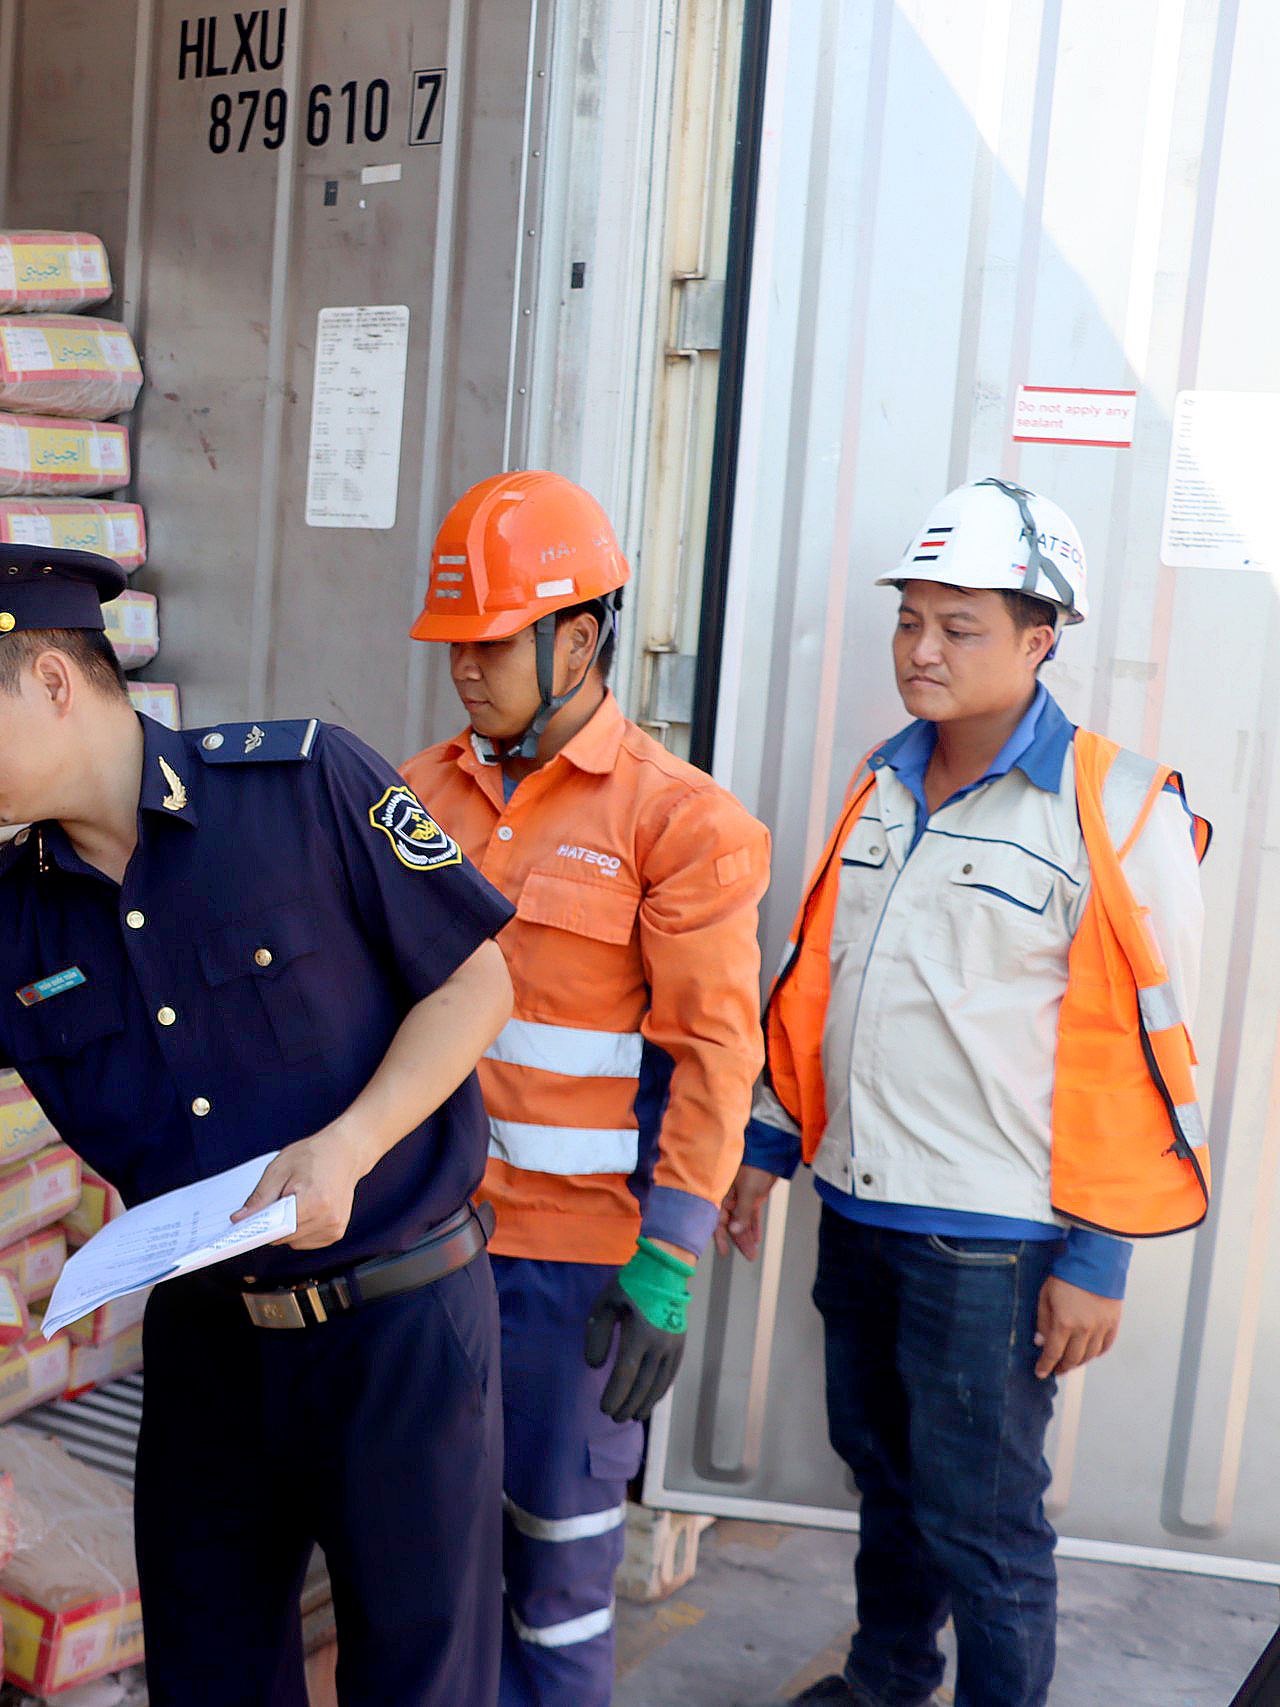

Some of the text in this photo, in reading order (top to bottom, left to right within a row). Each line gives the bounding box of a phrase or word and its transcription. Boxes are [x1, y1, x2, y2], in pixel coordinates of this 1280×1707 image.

[178, 7, 287, 80] HLXU
[209, 74, 442, 154] 879 610 7
[1018, 400, 1129, 419] Do not apply any
[1017, 417, 1063, 429] sealant
[556, 845, 621, 869] HATECO
